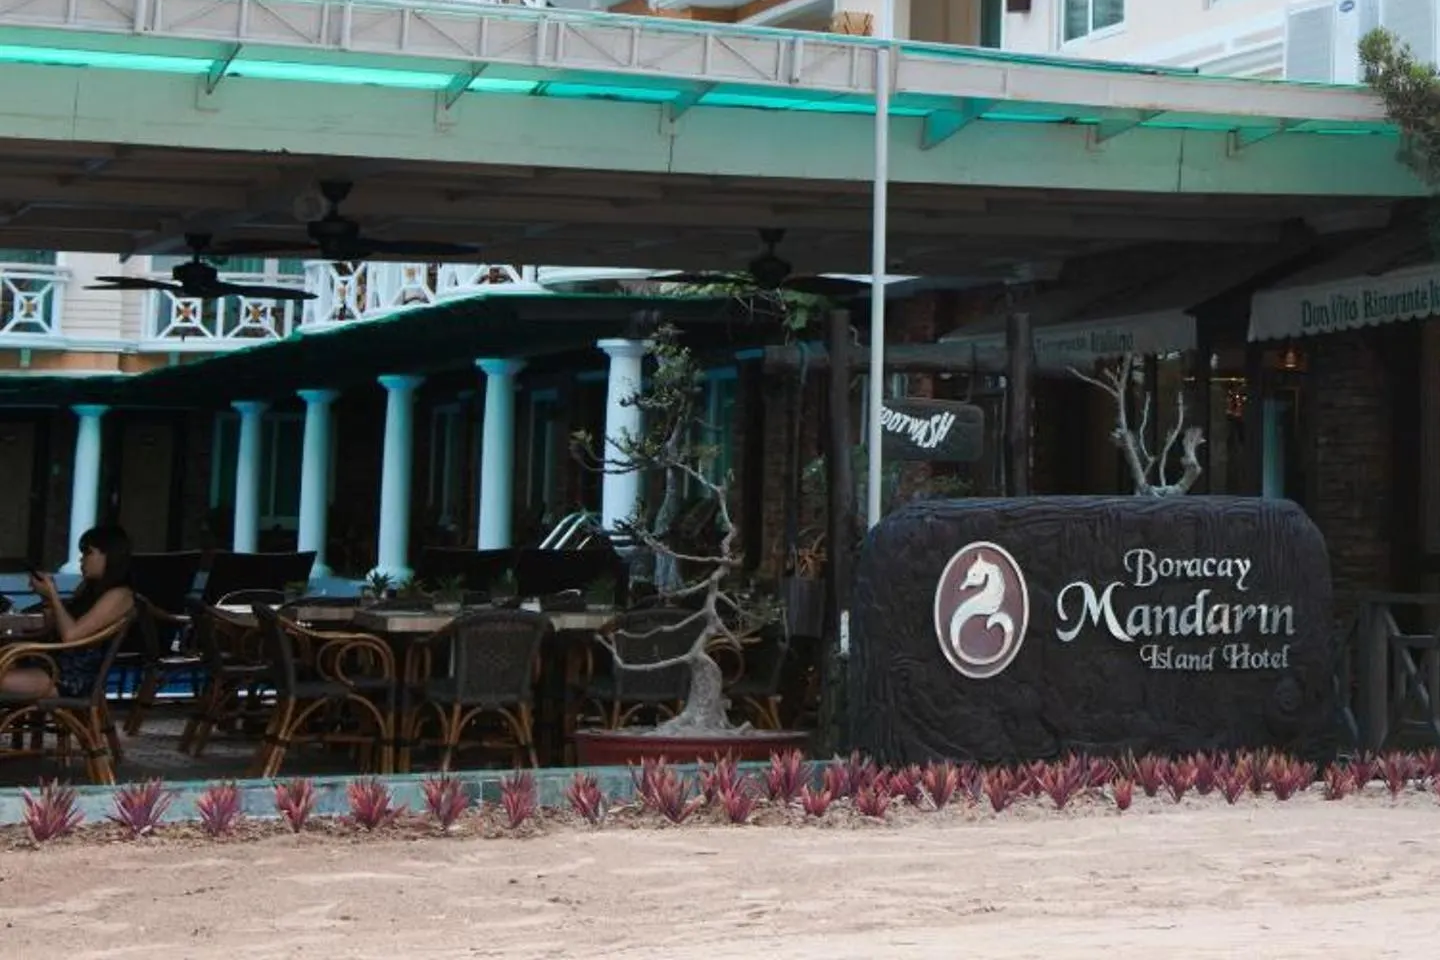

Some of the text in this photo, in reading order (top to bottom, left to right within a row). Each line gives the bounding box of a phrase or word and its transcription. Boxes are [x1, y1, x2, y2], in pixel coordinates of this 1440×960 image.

[880, 406, 956, 448] OOTWASH
[1123, 548, 1251, 590] Boracay
[1055, 581, 1296, 642] Mandarin
[1139, 643, 1292, 671] Island Hotel
